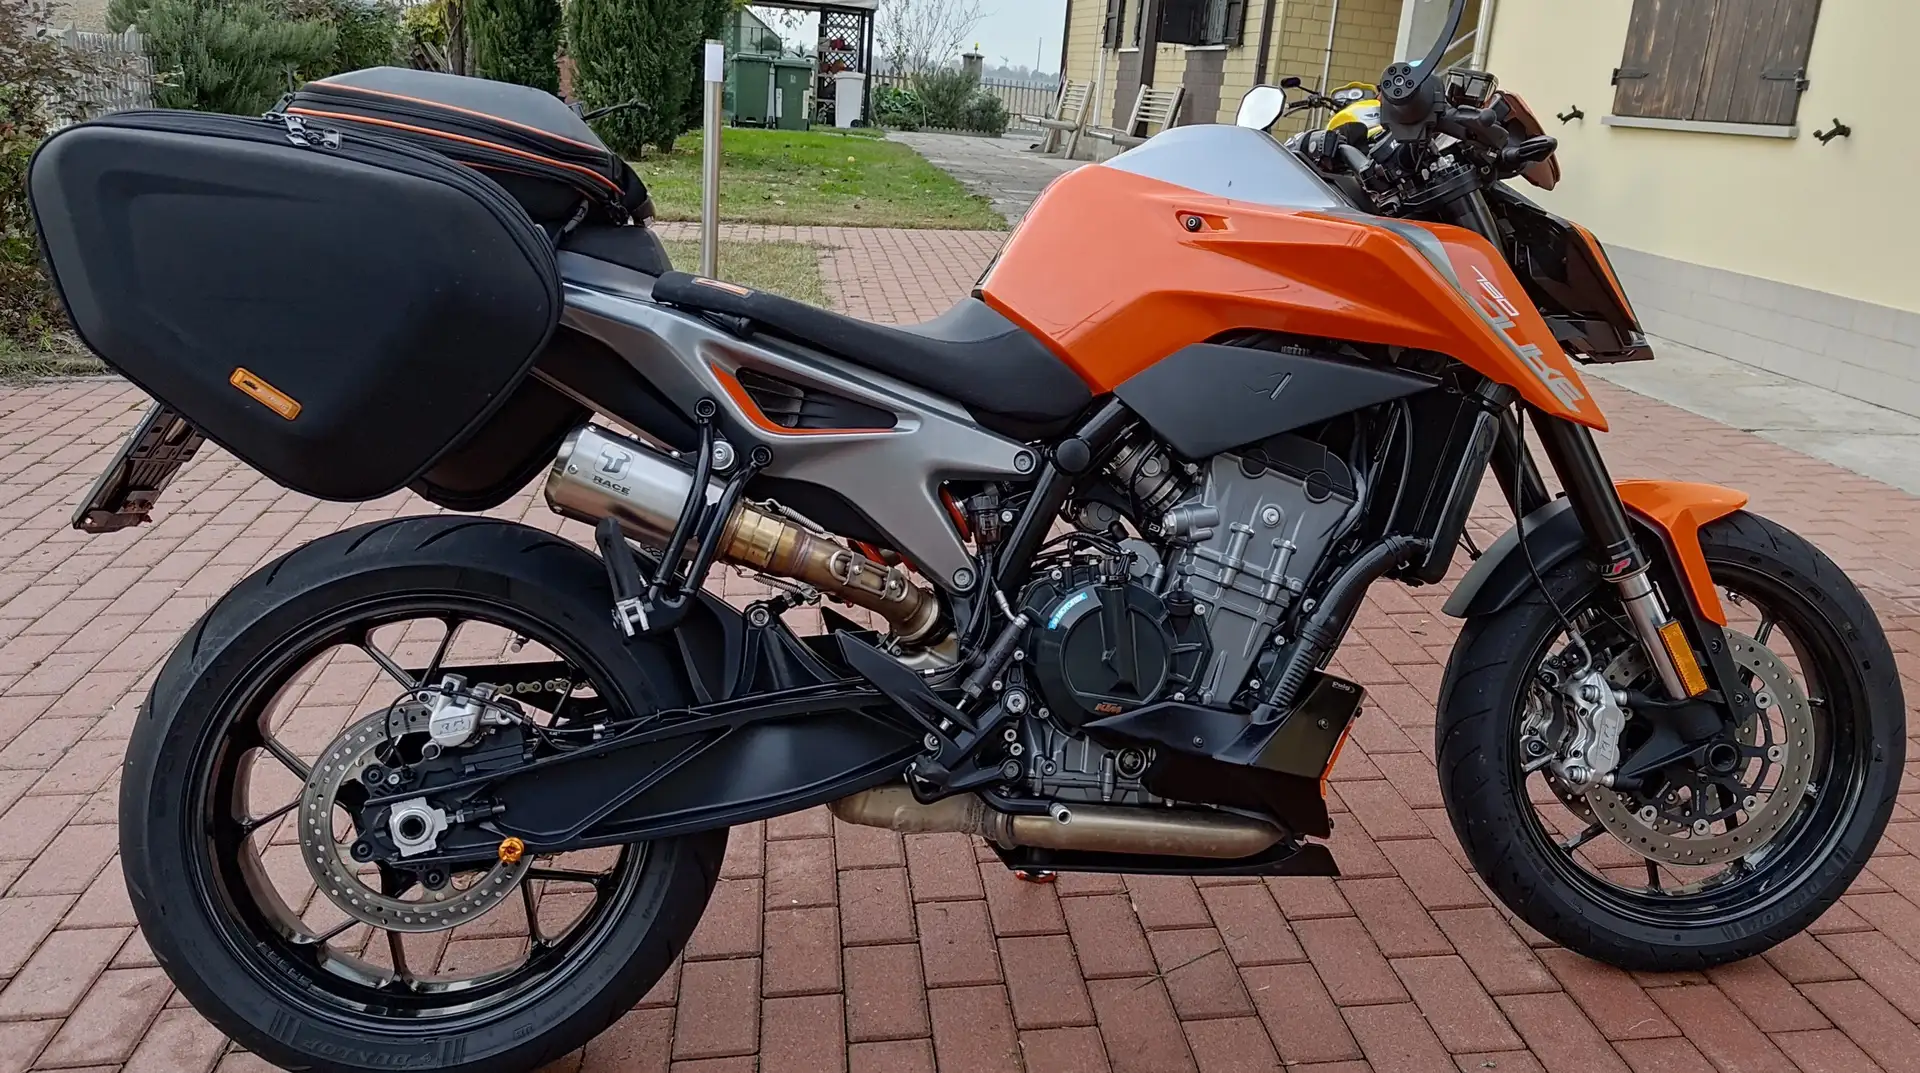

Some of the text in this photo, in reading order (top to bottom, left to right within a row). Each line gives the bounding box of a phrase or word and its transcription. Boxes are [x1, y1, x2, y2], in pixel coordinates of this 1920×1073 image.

[1470, 264, 1520, 317] 790
[1478, 294, 1585, 413] DUKE
[593, 475, 631, 495] RACE
[1094, 702, 1123, 714] KTM
[301, 1038, 412, 1067] DUNLOP
